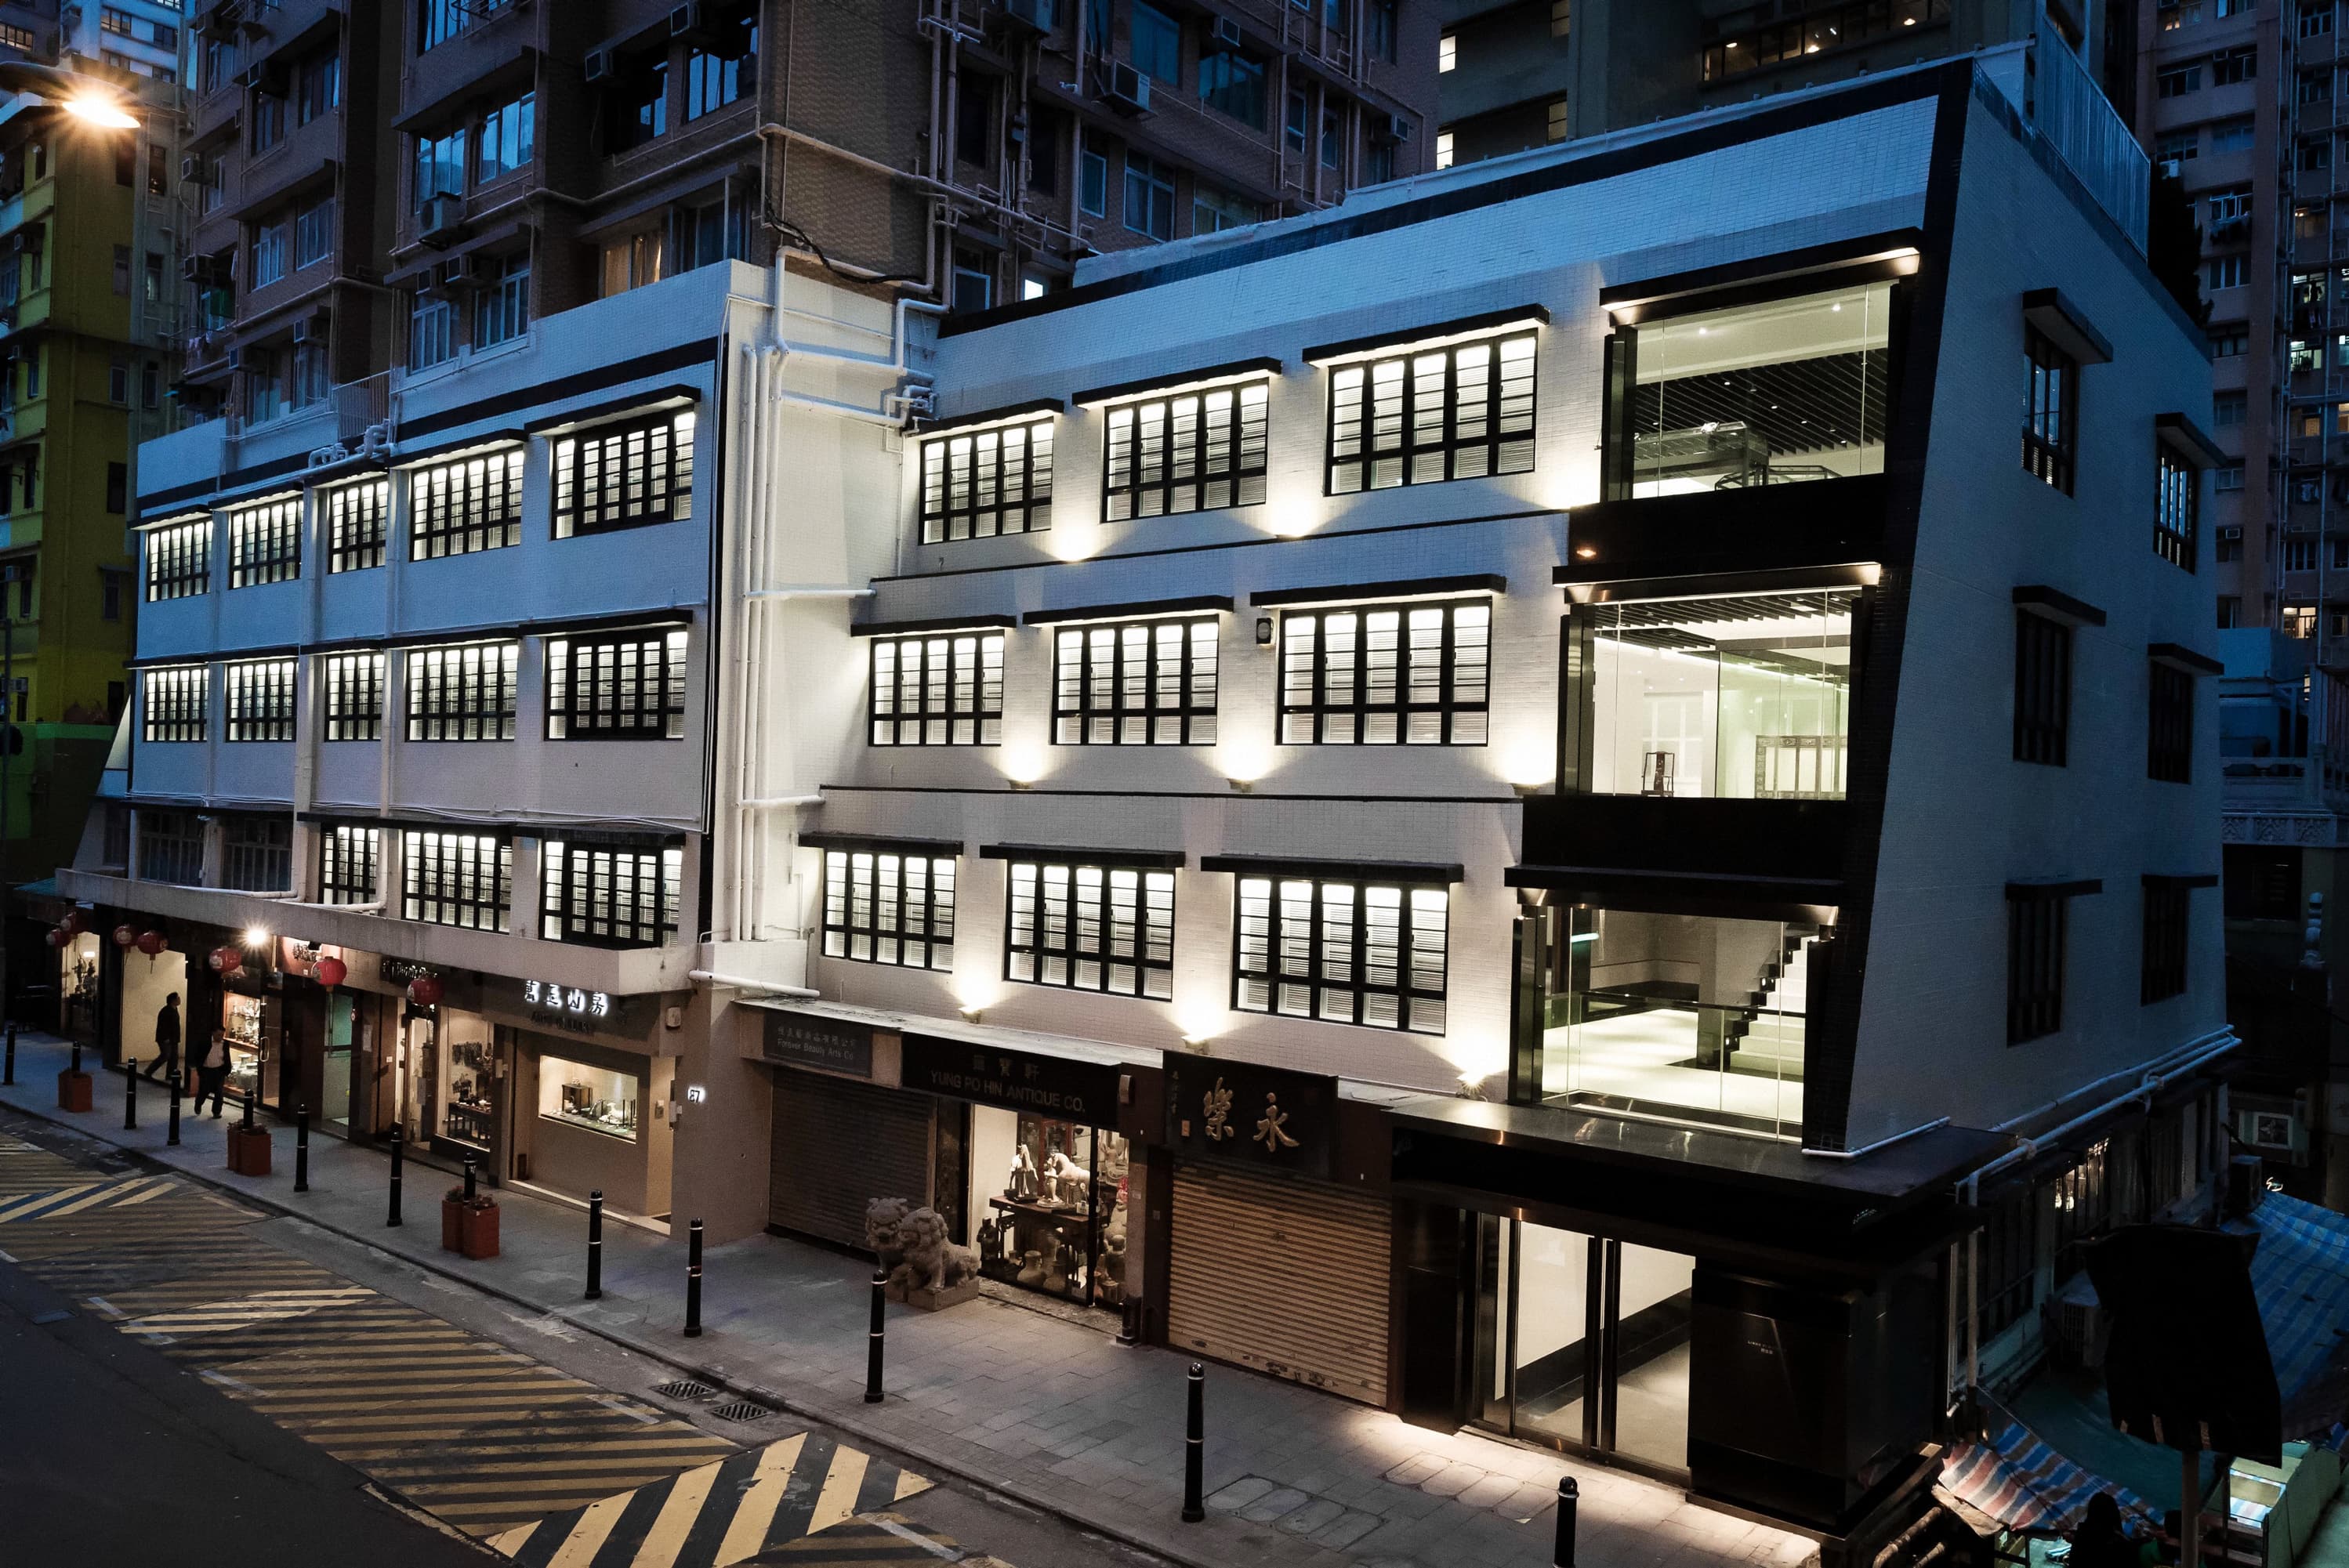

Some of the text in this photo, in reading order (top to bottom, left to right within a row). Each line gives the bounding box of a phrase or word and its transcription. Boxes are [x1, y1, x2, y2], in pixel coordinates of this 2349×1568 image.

[778, 1038, 801, 1050] Forever
[804, 1043, 825, 1056] Beauty
[828, 1048, 841, 1059] Arts
[930, 1070, 1086, 1113] YUNG PO HIN ANTIQUE CO.
